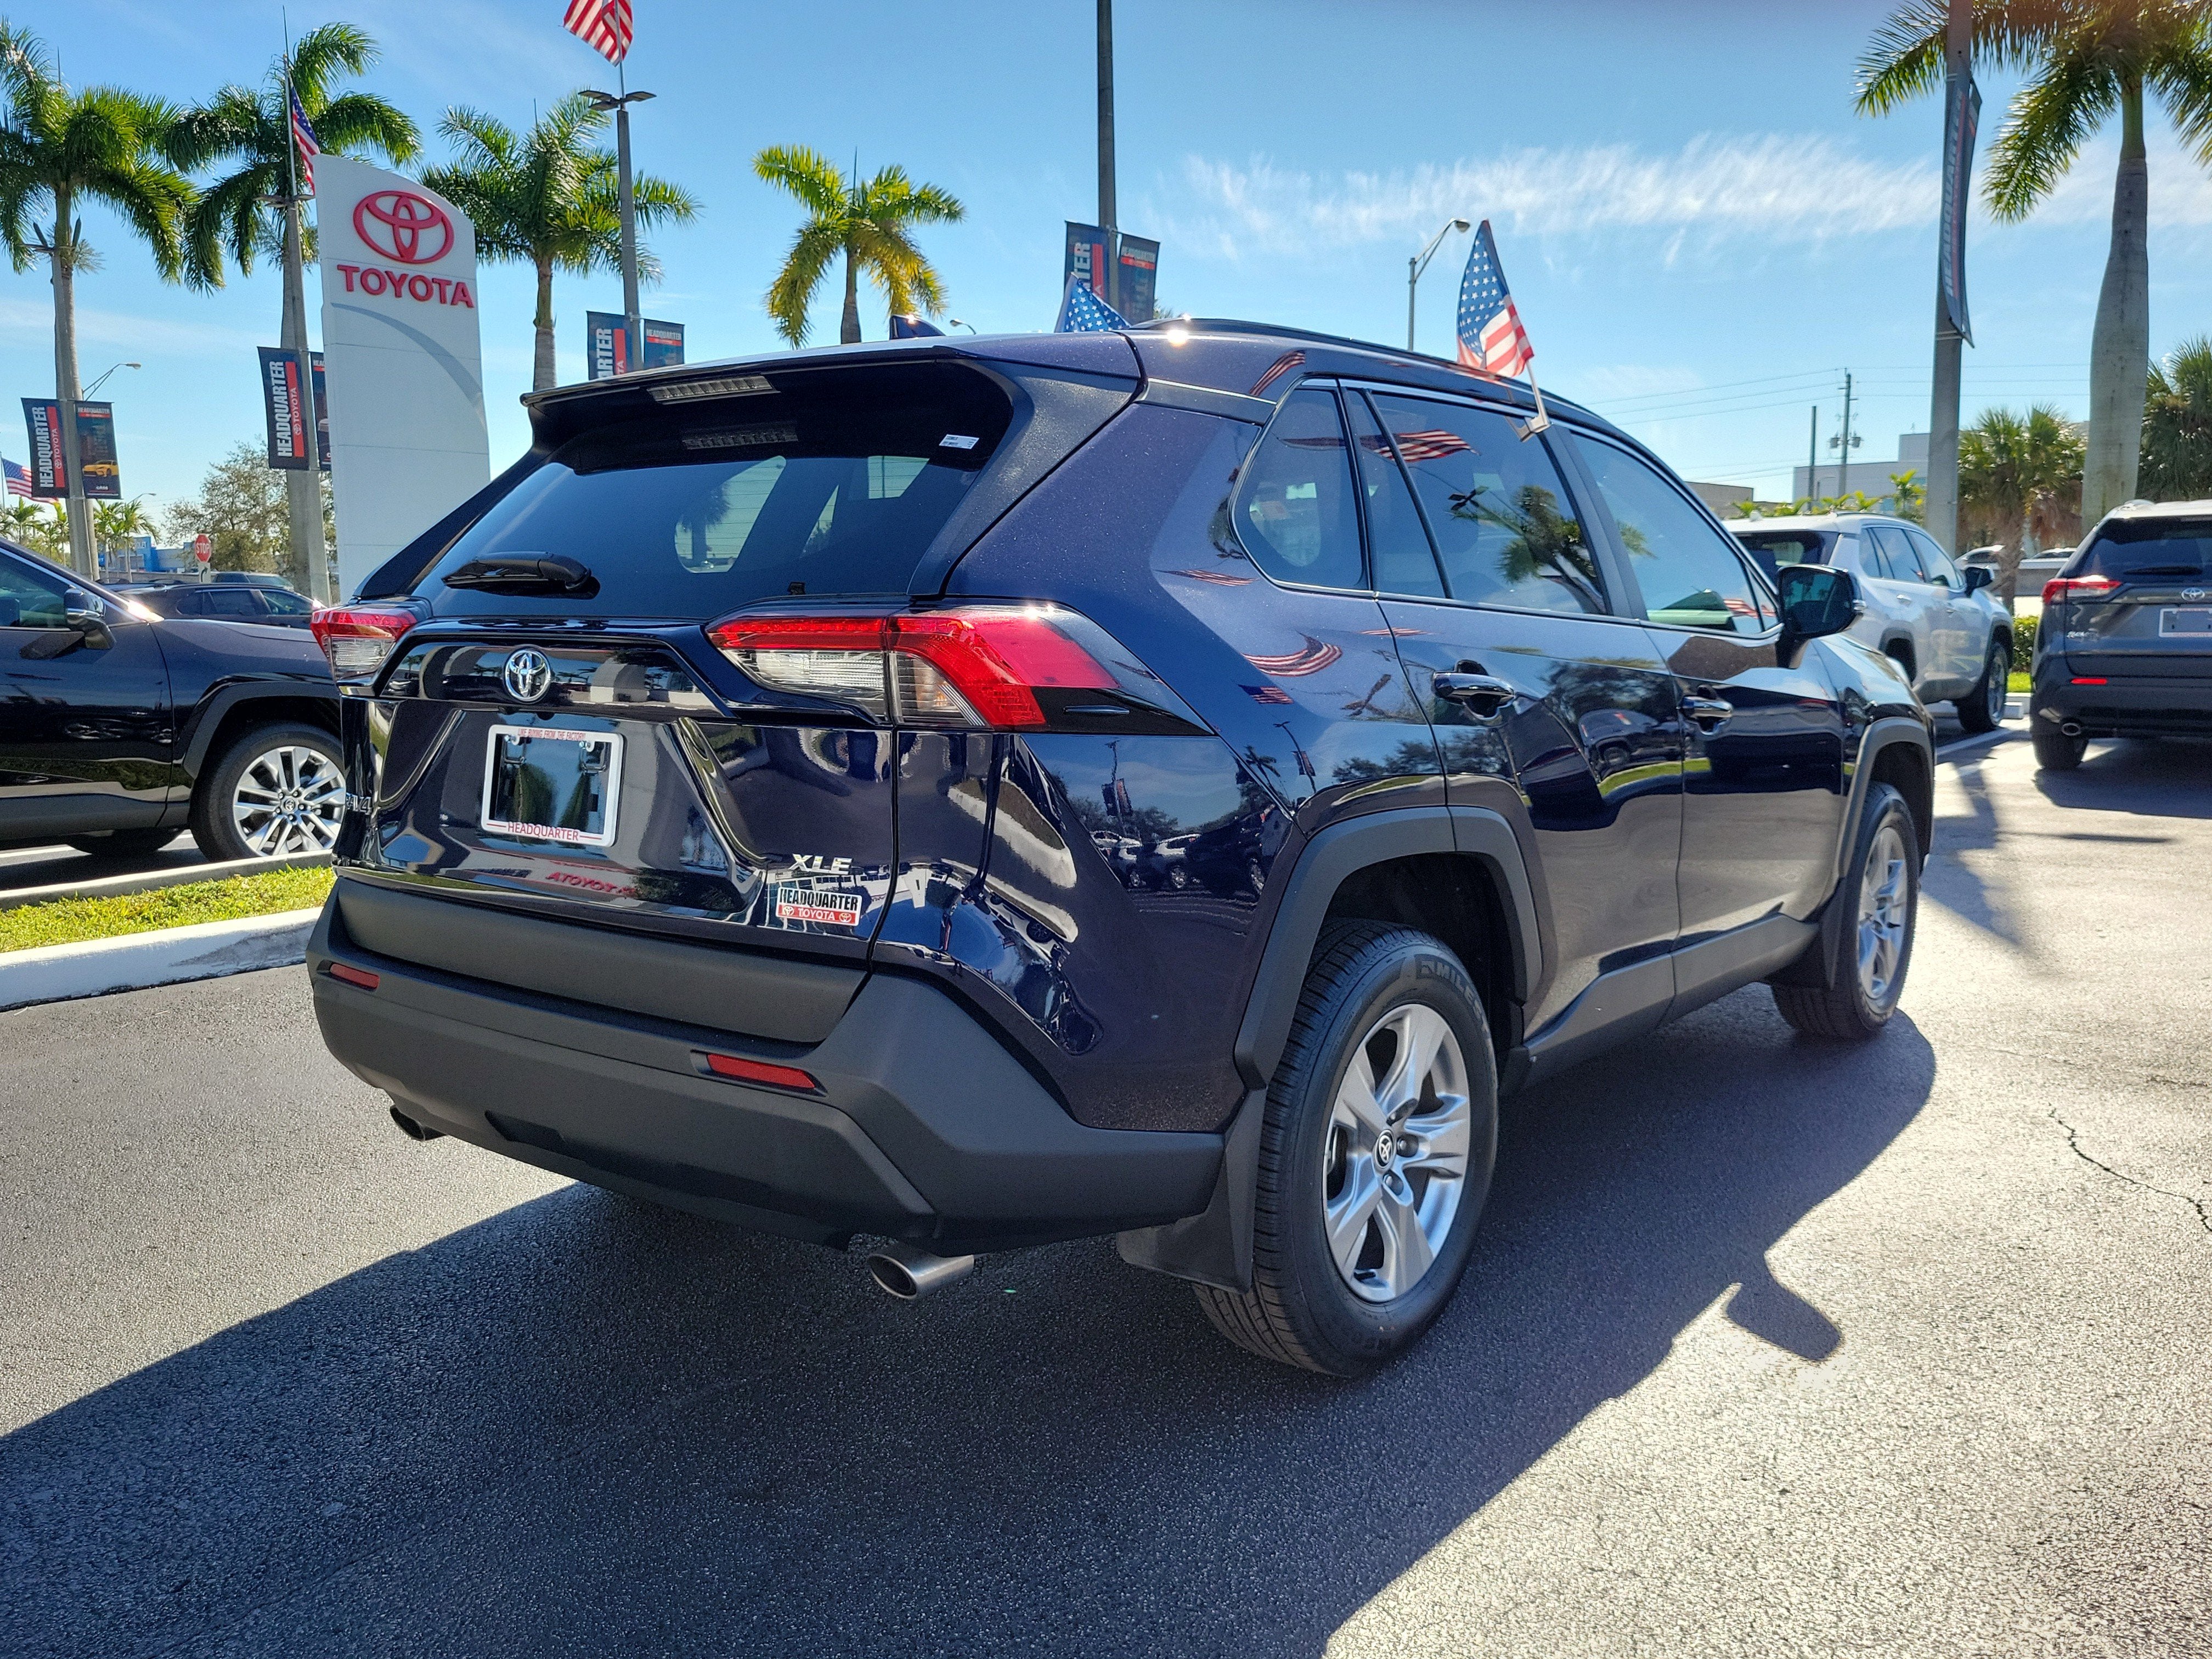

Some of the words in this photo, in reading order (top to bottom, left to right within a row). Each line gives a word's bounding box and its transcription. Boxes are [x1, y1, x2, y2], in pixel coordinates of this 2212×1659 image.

[337, 264, 475, 308] TOYOTA
[269, 361, 292, 457] HEADQUARTER
[290, 387, 301, 422] TOYOTA
[32, 406, 54, 488] HEADQUARTER
[52, 428, 62, 459] TOYOTA
[196, 543, 210, 554] STOP
[544, 730, 556, 739] FROM
[507, 822, 579, 841] HEADQUARTER
[788, 854, 853, 875] XLE
[780, 888, 859, 911] HEADQUARTER
[798, 908, 836, 921] TOYOTA
